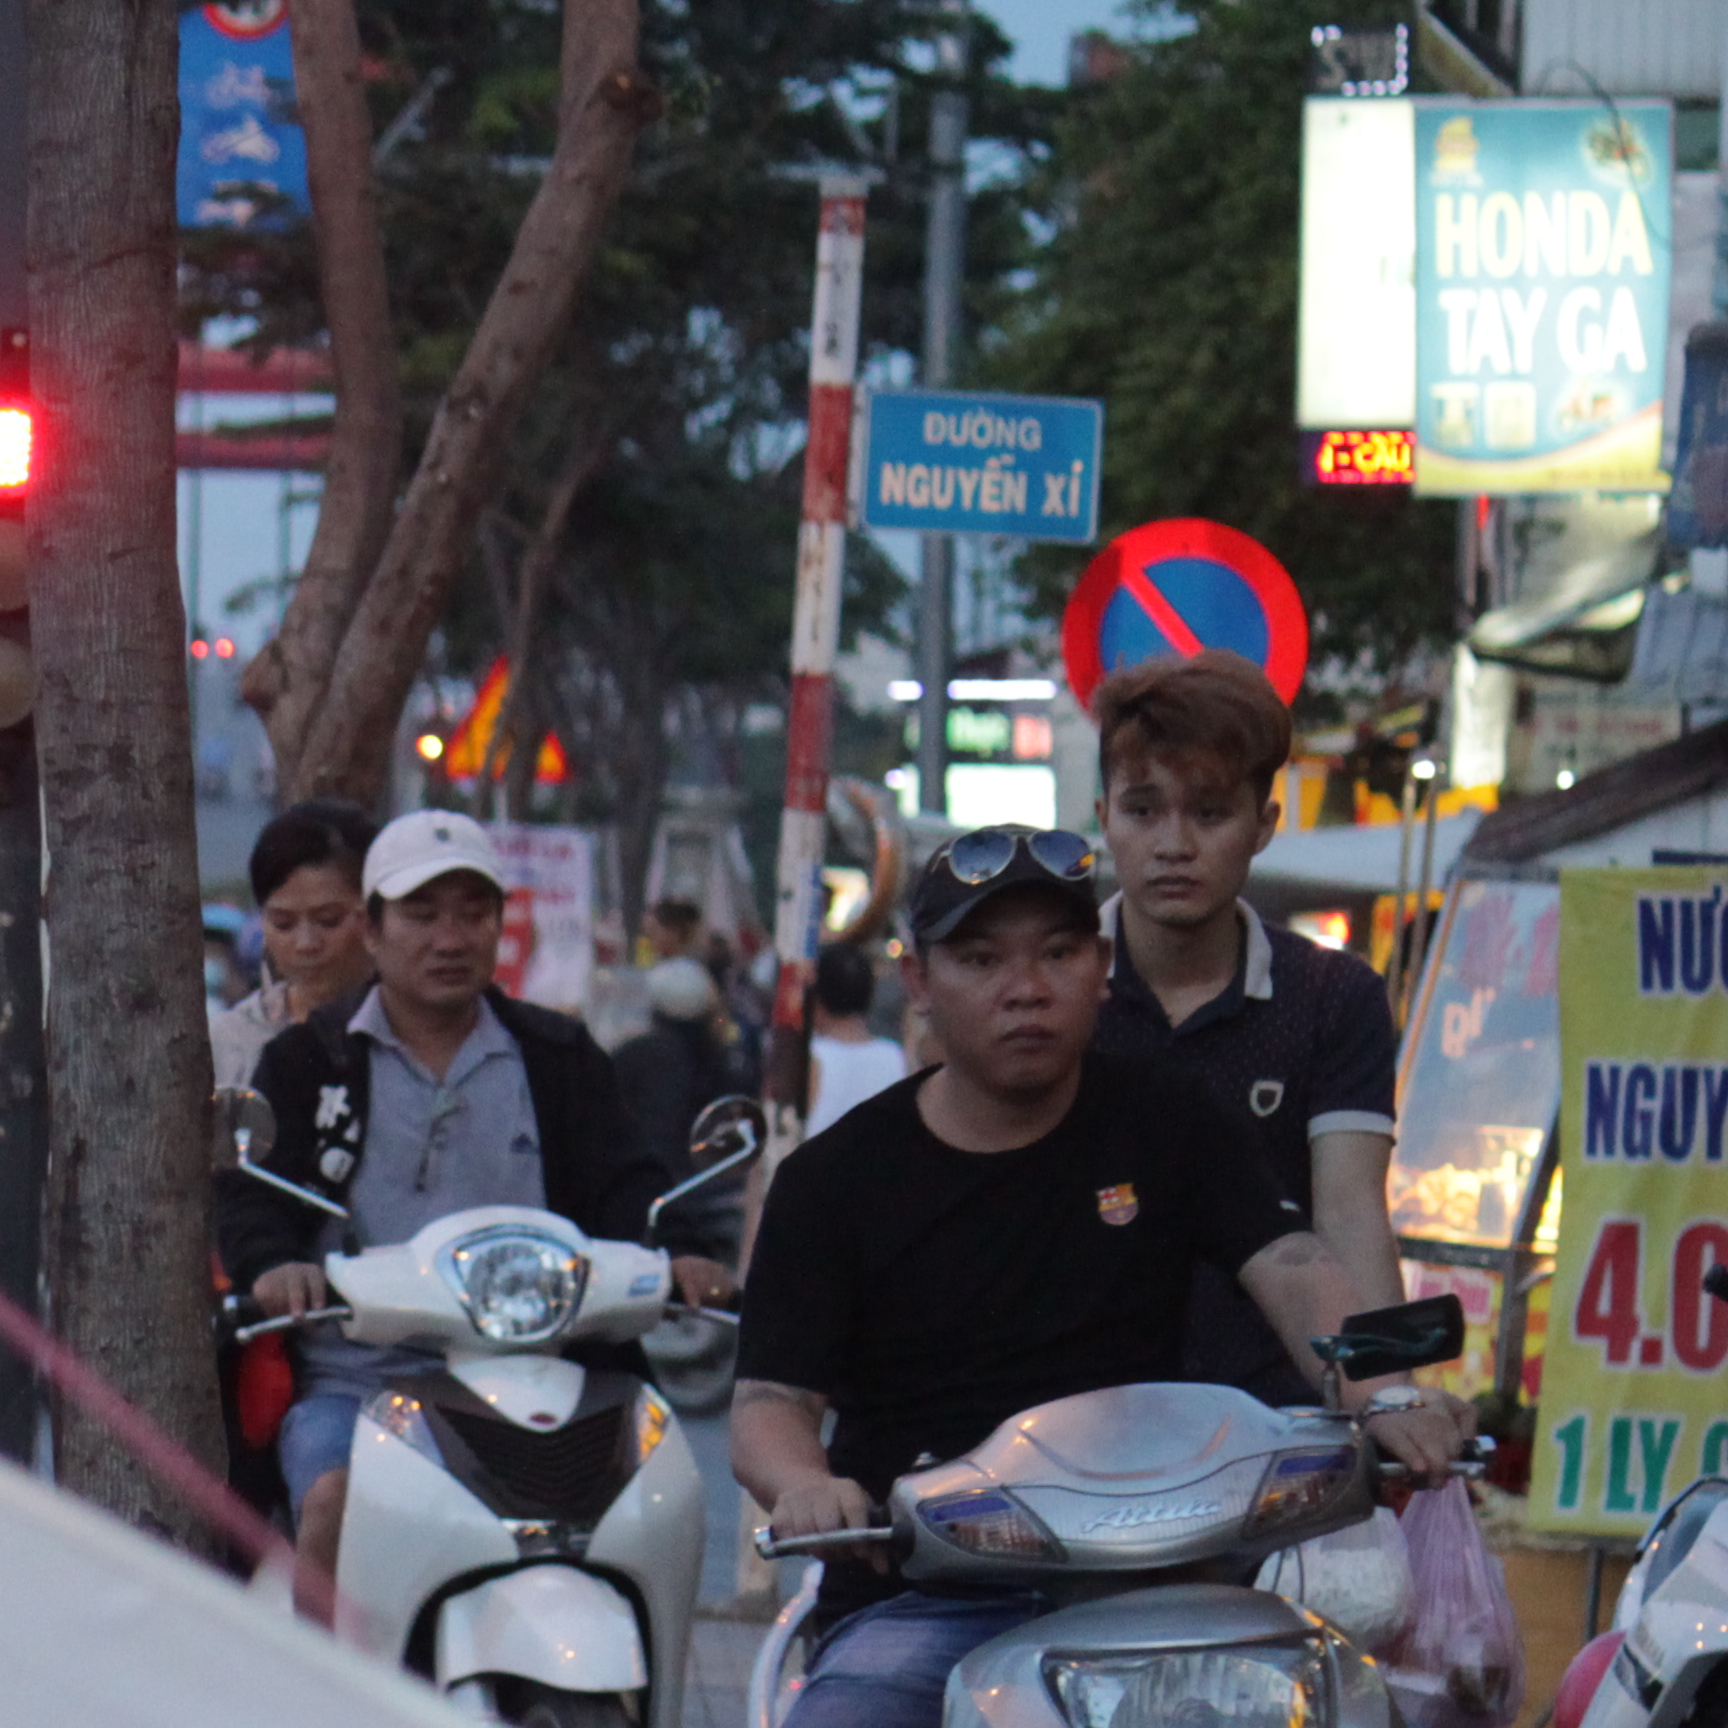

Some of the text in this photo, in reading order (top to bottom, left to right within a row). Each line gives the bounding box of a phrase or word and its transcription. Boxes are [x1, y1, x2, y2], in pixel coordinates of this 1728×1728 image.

[1435, 190, 1653, 279] HONDA
[1438, 285, 1647, 375] TAY GA
[880, 454, 1028, 514] NGUYỄN
[1639, 885, 1728, 994] NƯ
[1586, 1063, 1728, 1162] NGUY
[1555, 1416, 1586, 1509] 1
[1604, 1417, 1681, 1513] LY
